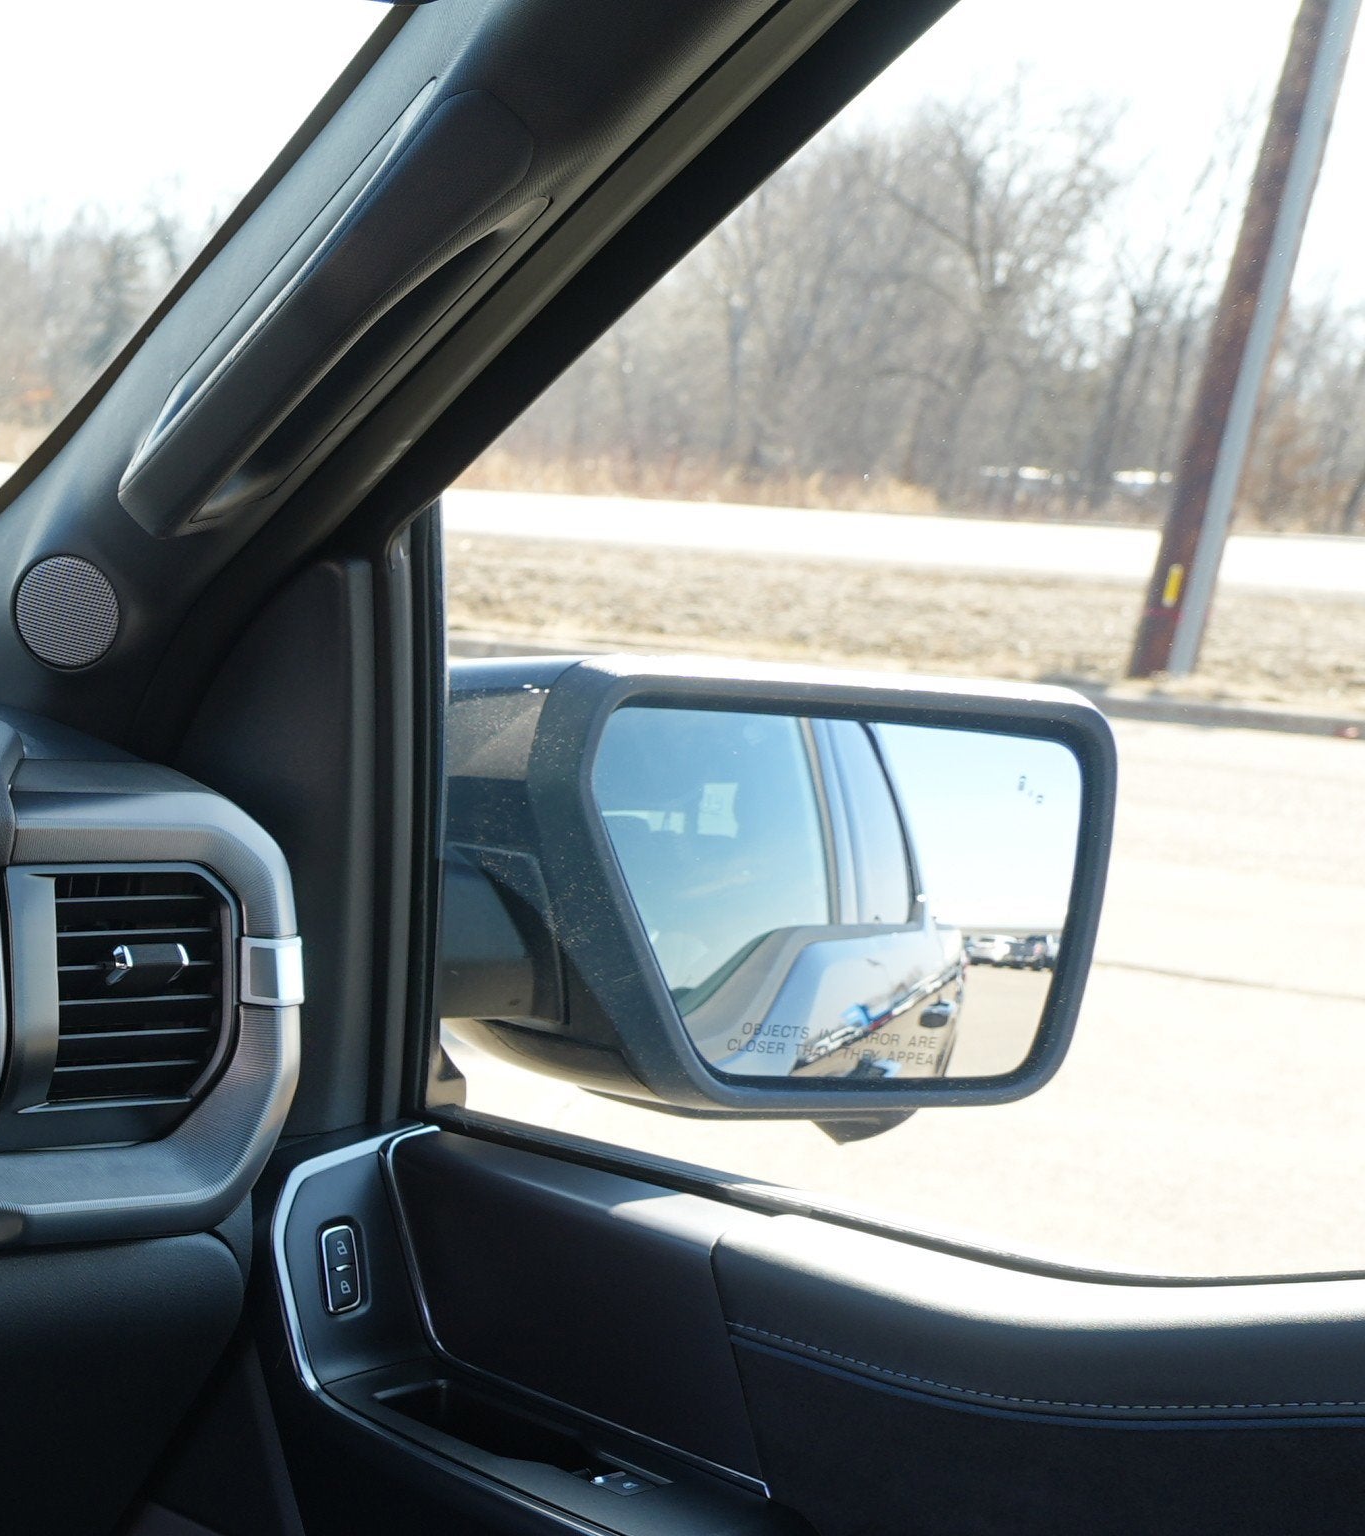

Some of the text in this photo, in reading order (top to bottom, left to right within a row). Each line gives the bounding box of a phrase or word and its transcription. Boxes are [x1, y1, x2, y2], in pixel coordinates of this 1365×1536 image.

[727, 1038, 785, 1055] CLOSER
[742, 1022, 811, 1040] OBJECTS
[907, 1034, 938, 1049] ARE
